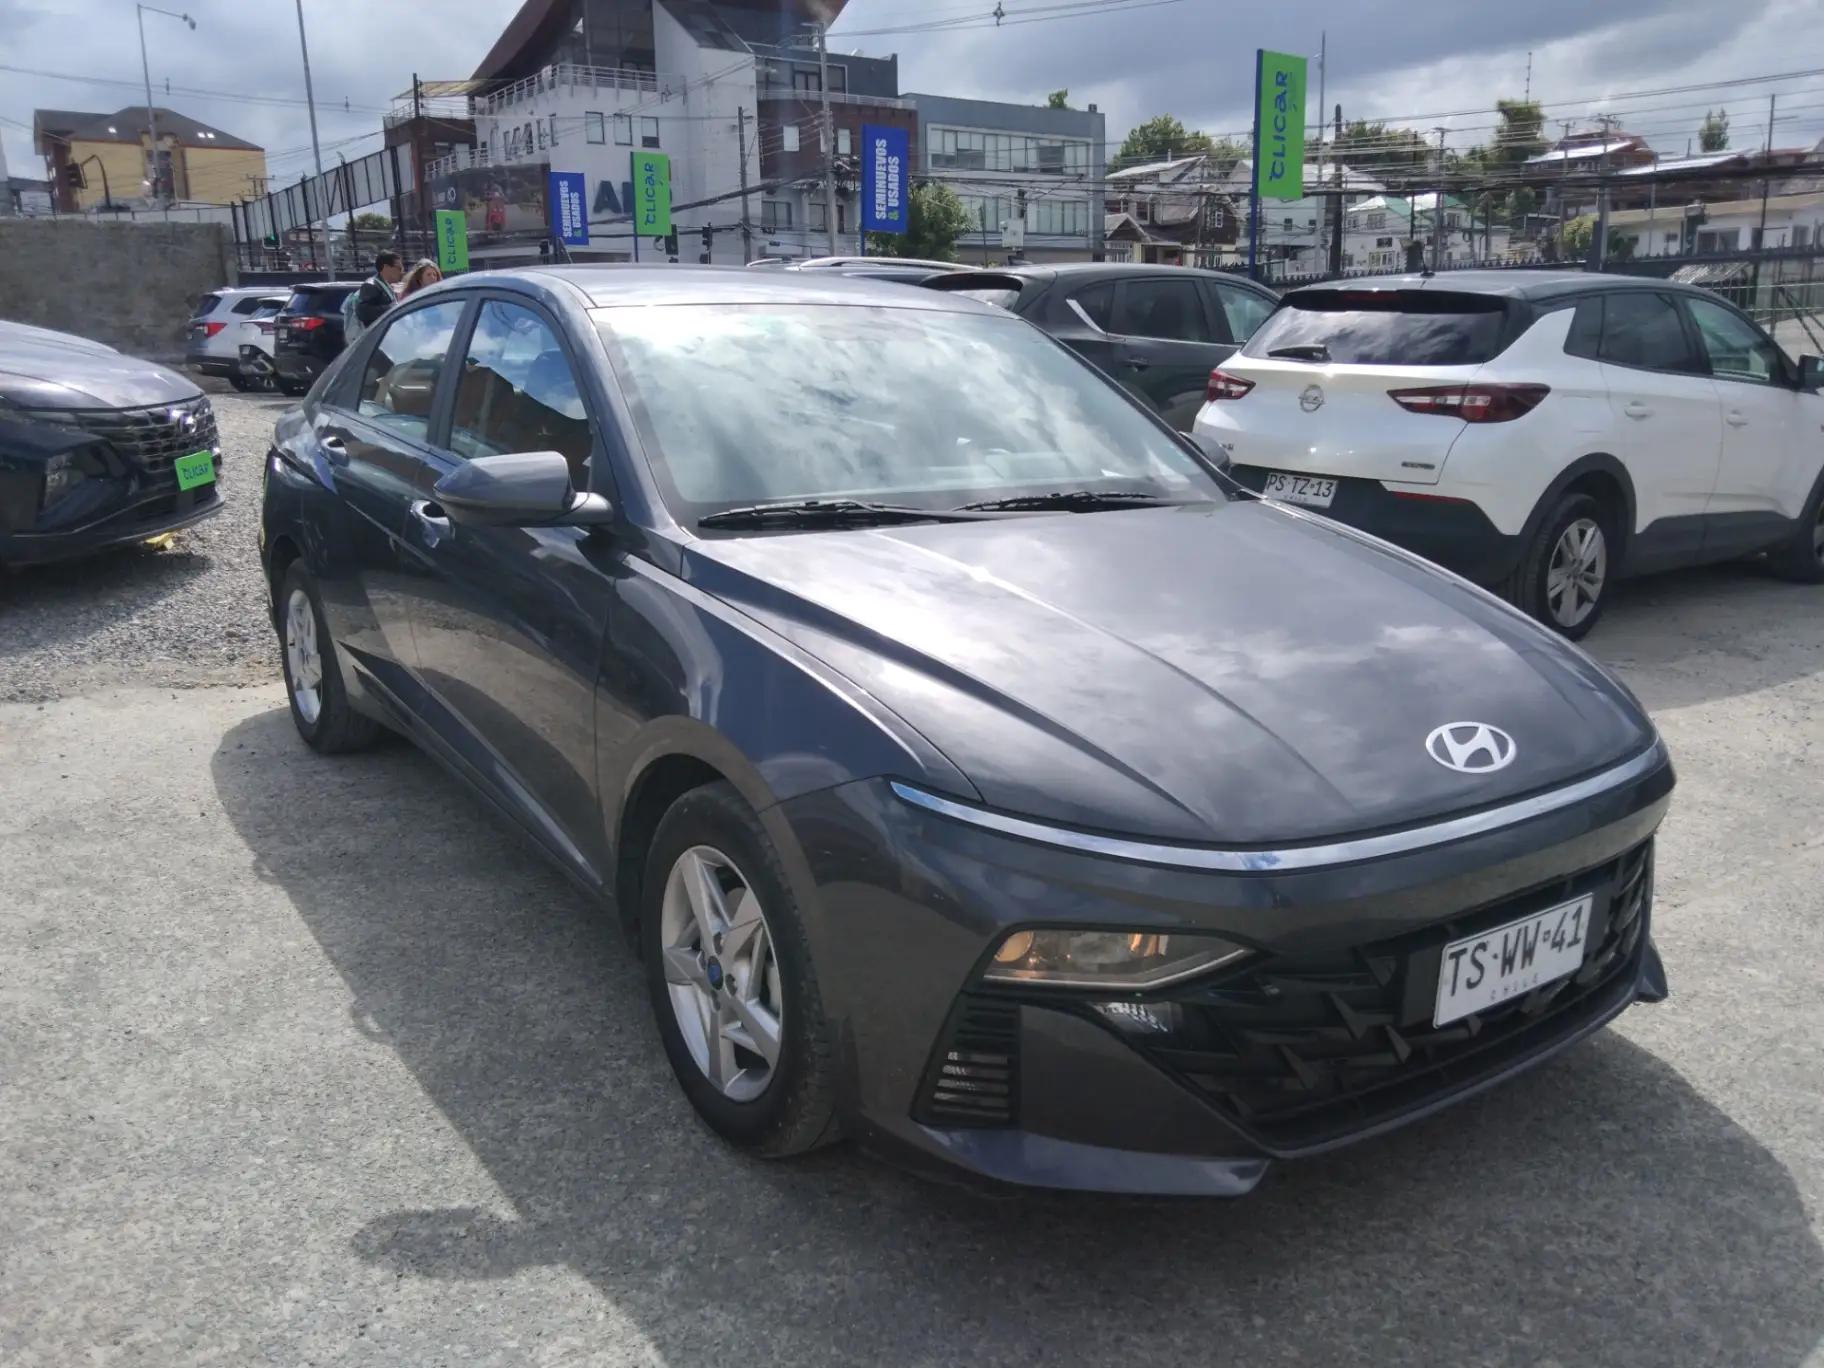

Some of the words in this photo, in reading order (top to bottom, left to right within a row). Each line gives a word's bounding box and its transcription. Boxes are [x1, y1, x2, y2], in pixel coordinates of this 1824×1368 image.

[875, 138, 888, 220] SEMINUEVOS
[887, 156, 900, 207] USADOS
[559, 180, 573, 238] SEMINUEVOS
[570, 192, 582, 228] USADOS
